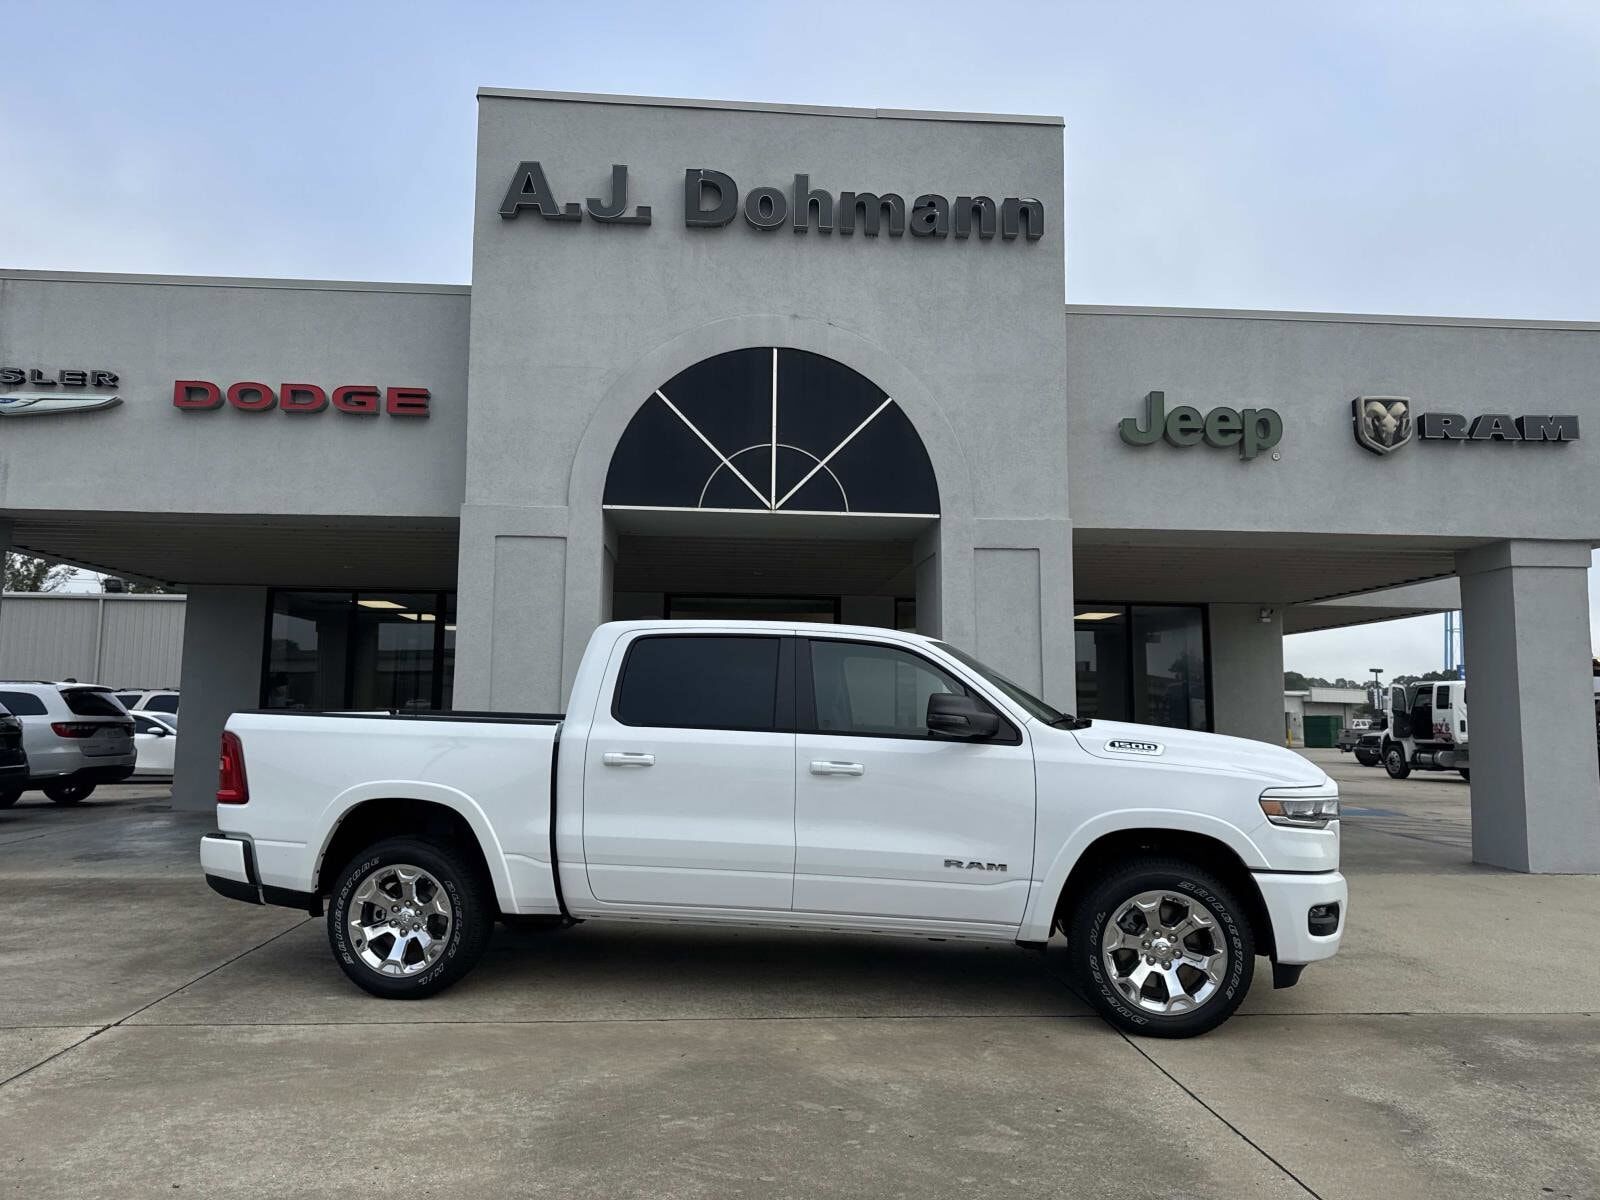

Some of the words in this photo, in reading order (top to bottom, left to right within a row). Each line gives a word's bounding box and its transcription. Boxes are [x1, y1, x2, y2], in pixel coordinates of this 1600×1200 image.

[498, 161, 651, 225] A.J.
[685, 167, 1044, 241] Dohmann
[173, 380, 431, 417] DODGE
[1119, 391, 1283, 460] Jeep
[1417, 412, 1580, 441] RAM
[1111, 740, 1158, 751] 1500
[943, 858, 1008, 872] RAM
